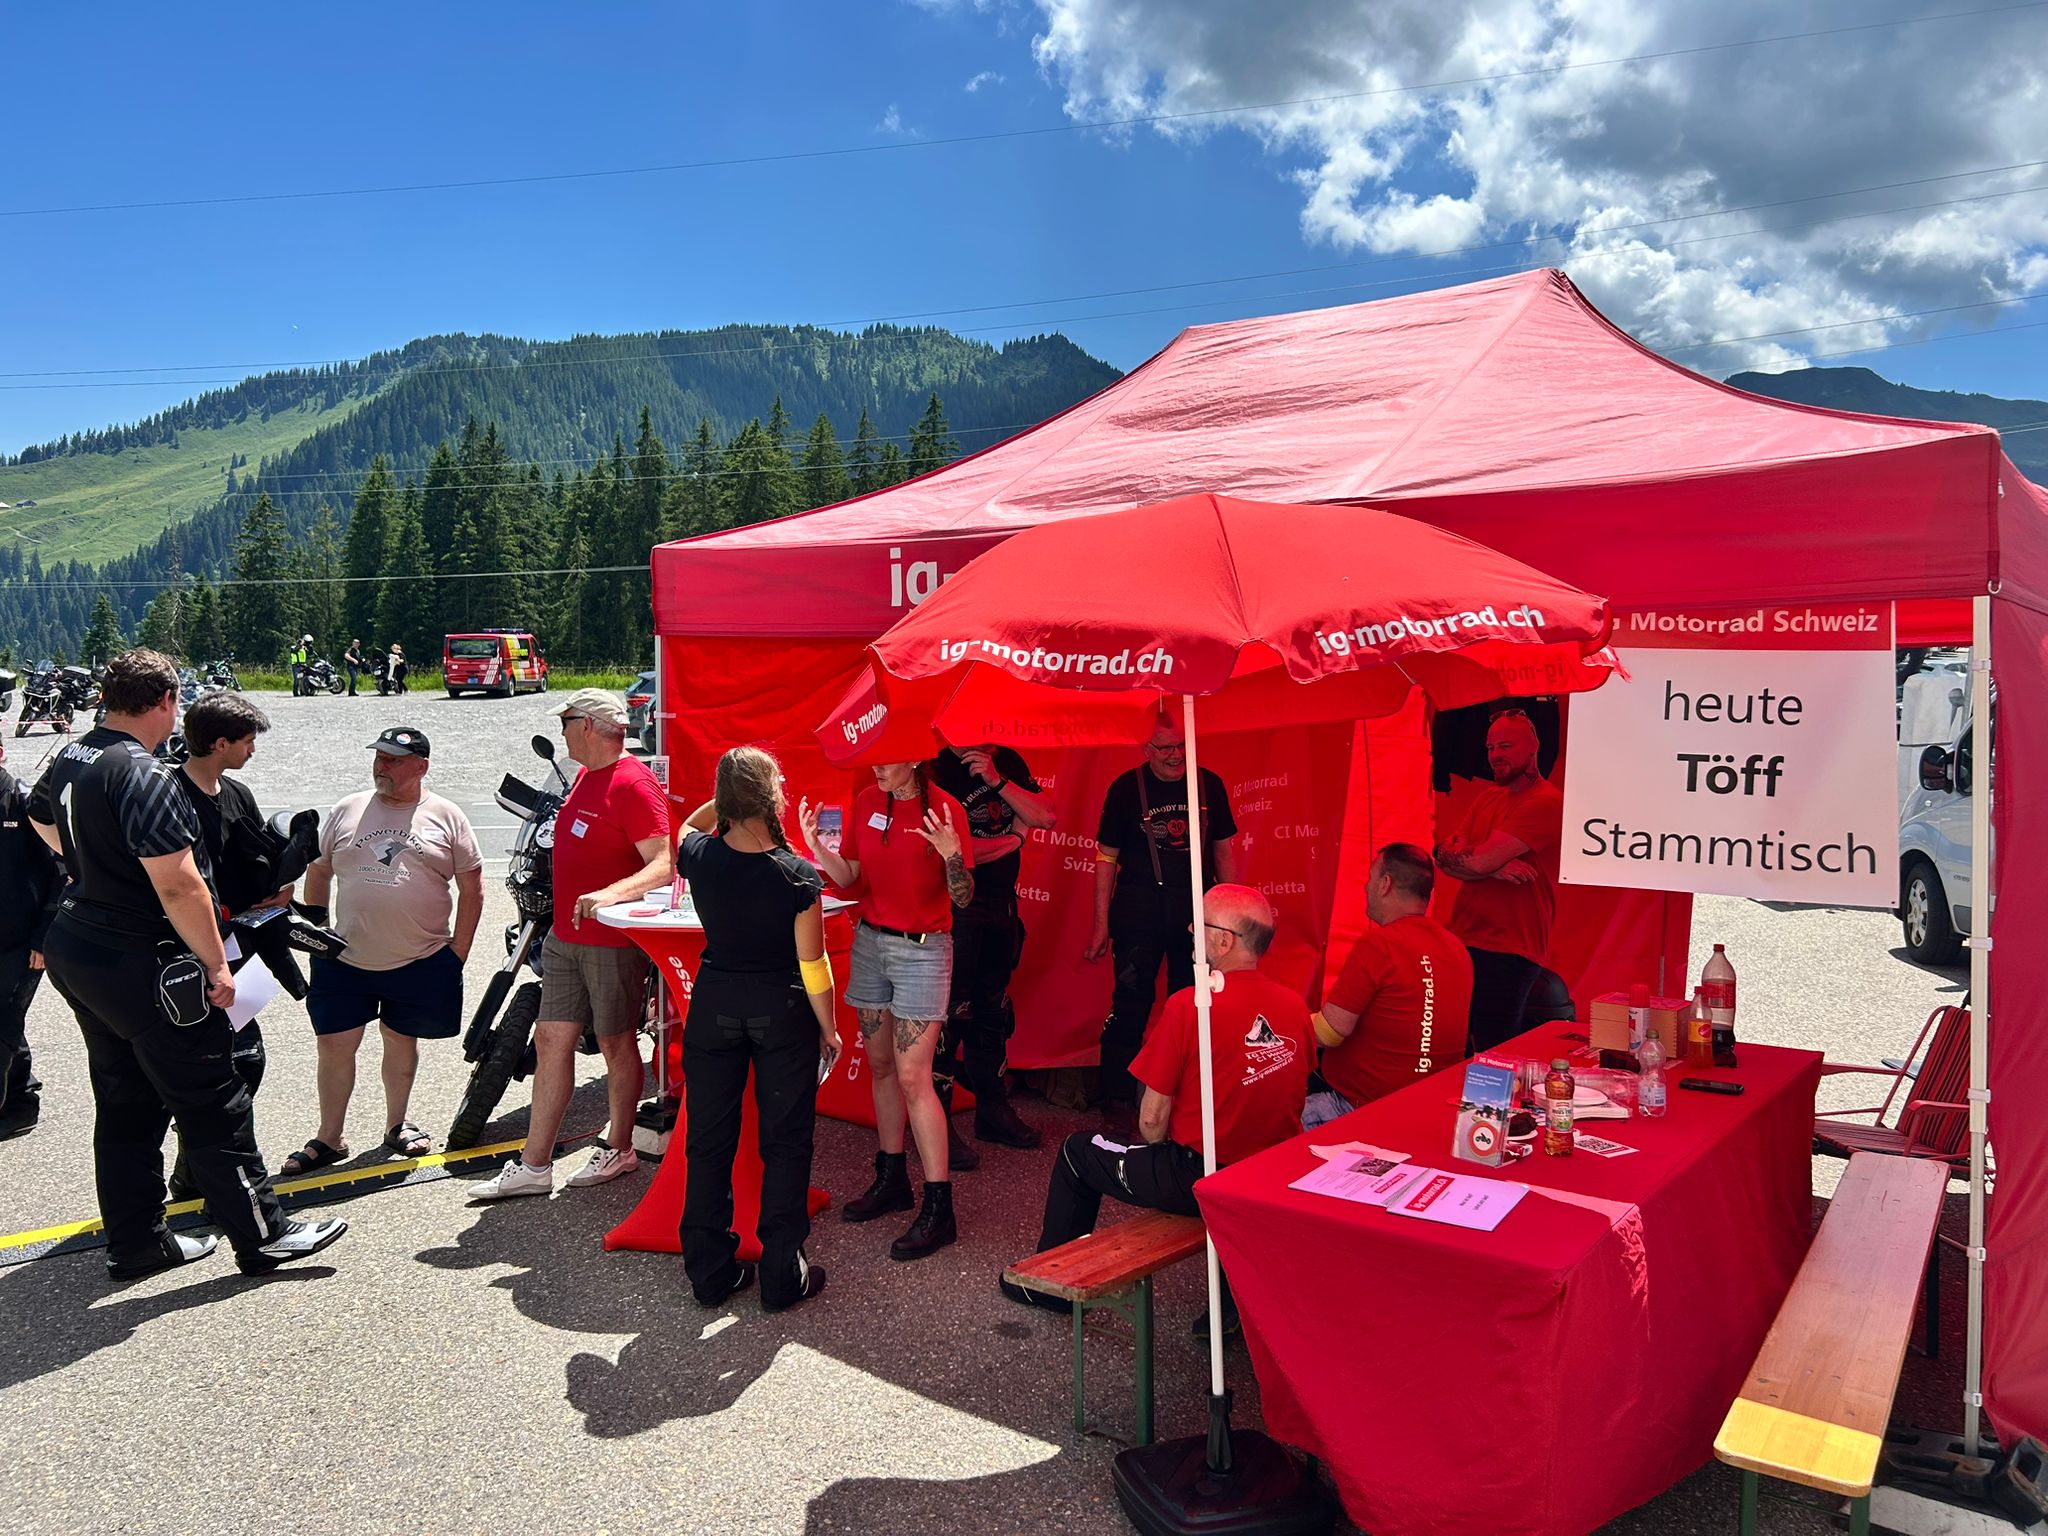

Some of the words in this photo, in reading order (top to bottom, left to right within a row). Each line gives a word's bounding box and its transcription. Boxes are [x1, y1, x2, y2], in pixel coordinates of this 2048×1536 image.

[1316, 604, 1545, 656] ig-motorrad.ch
[1630, 611, 1764, 634] Motorrad
[1773, 608, 1878, 632] Schweiz
[940, 638, 1174, 676] ig-motorrad.ch
[1663, 680, 1803, 725] heute
[63, 742, 105, 765] SOMMER
[1677, 753, 1785, 798] Töff
[60, 781, 77, 849] 1
[1274, 826, 1291, 839] CI
[355, 828, 425, 857] Powerbiker
[1032, 828, 1047, 843] CI
[1582, 818, 1877, 874] Stammtisch
